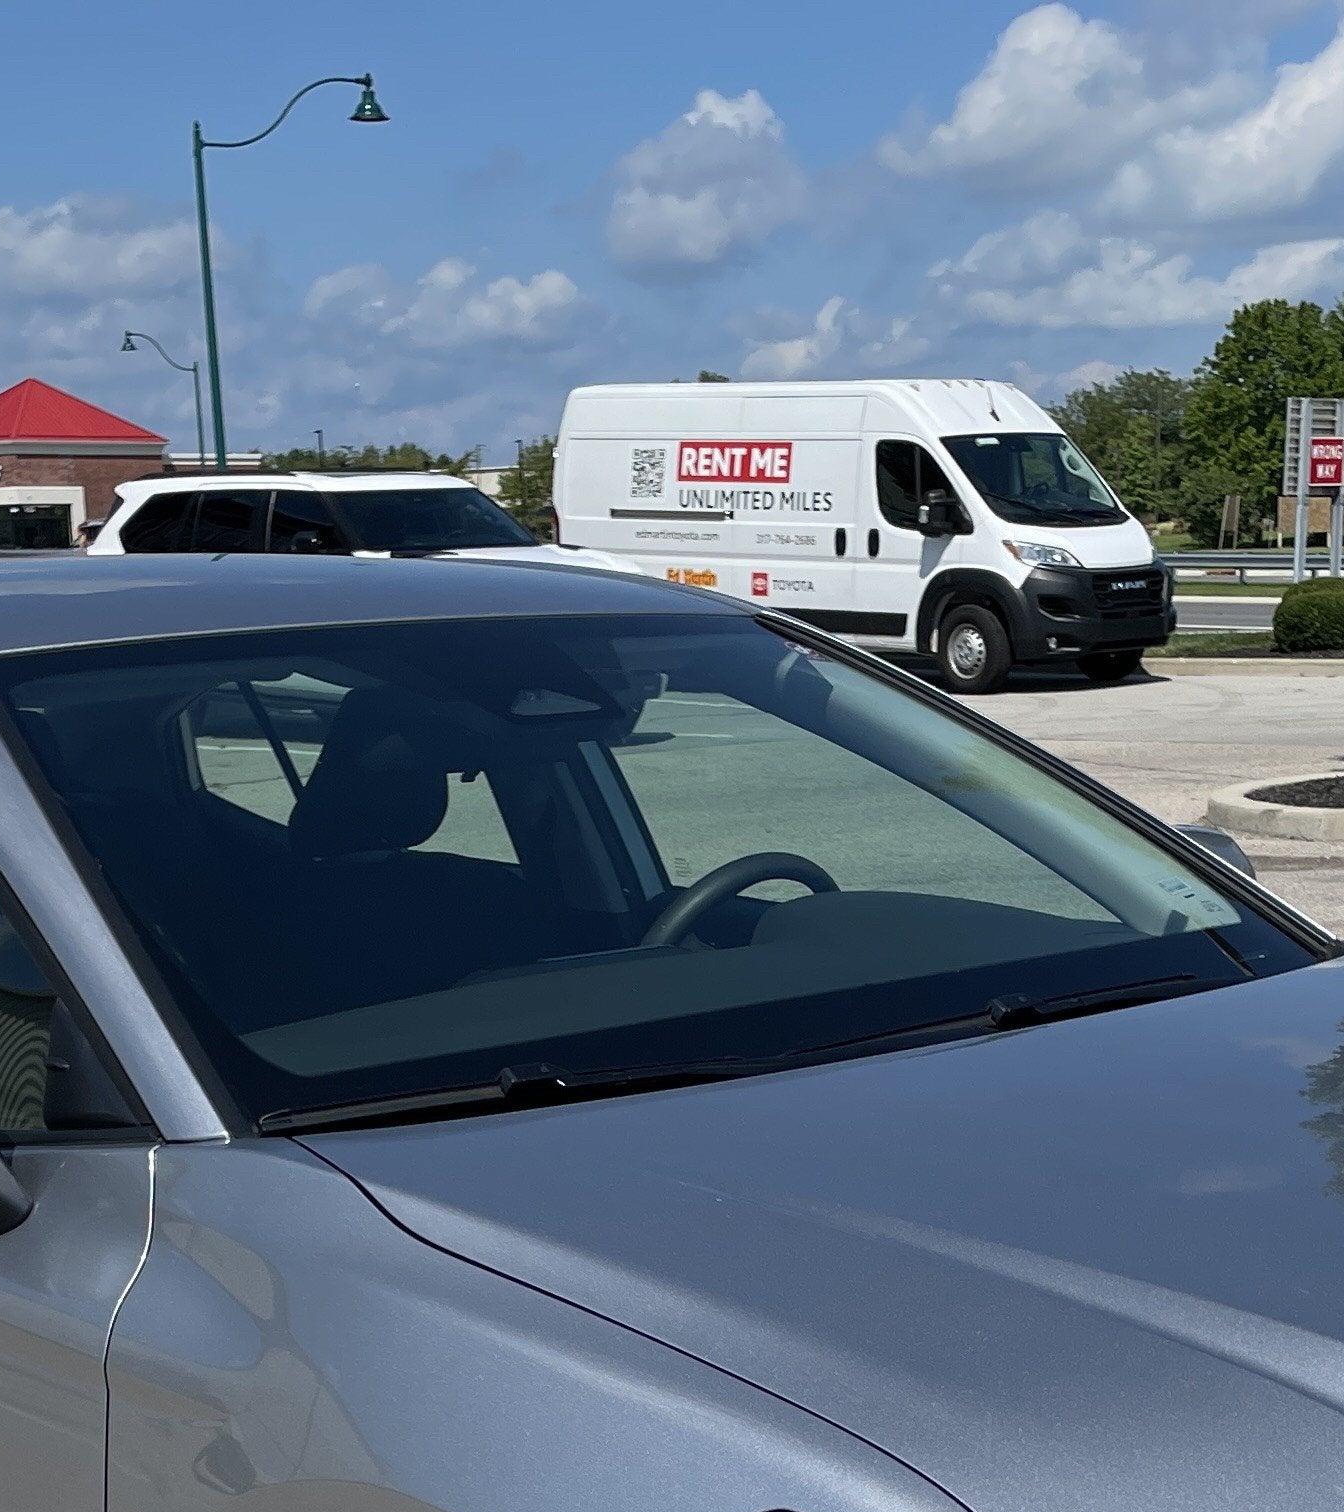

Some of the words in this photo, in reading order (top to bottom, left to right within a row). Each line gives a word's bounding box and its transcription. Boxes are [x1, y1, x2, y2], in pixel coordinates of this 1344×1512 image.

[1311, 444, 1344, 460] WRONG
[679, 447, 747, 479] RENT
[749, 447, 788, 479] ME
[678, 488, 774, 512] UNLIMITED
[779, 491, 834, 513] MILES
[772, 579, 816, 593] TOYOTA
